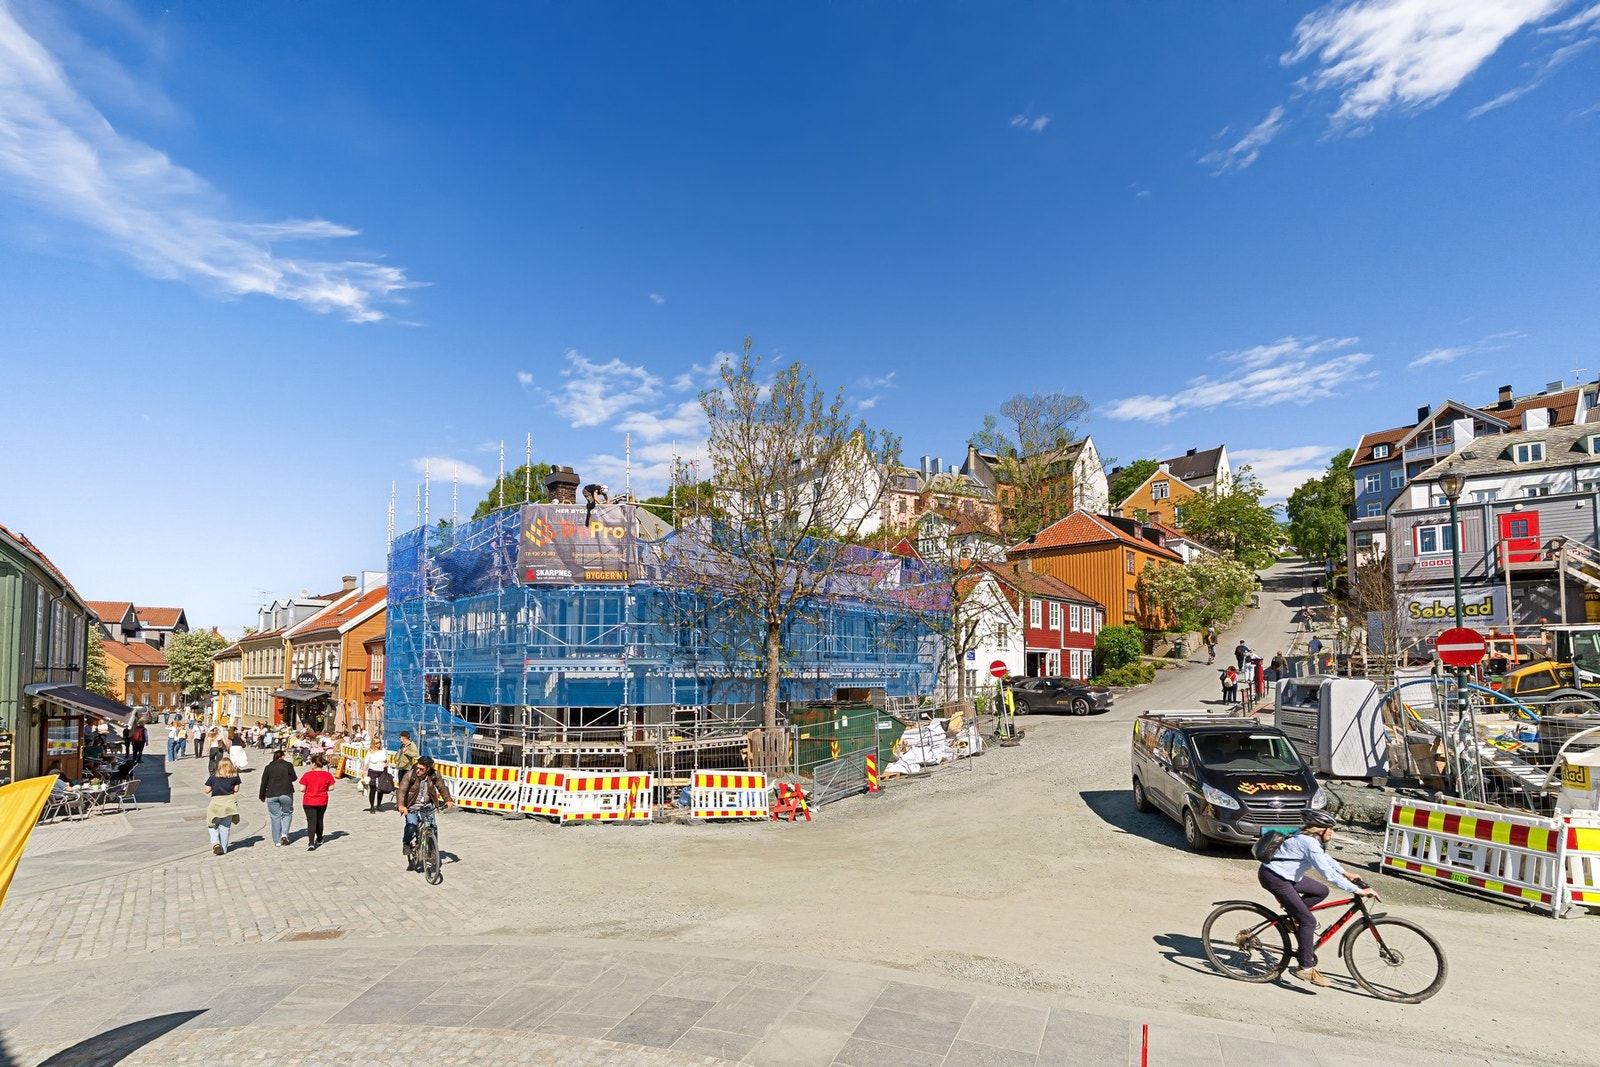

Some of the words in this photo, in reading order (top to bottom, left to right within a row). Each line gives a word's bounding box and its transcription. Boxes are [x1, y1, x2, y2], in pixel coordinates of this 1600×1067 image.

[536, 569, 572, 577] SKARPNES
[1409, 596, 1494, 619] Søbsad
[1256, 782, 1303, 791] TrePro
